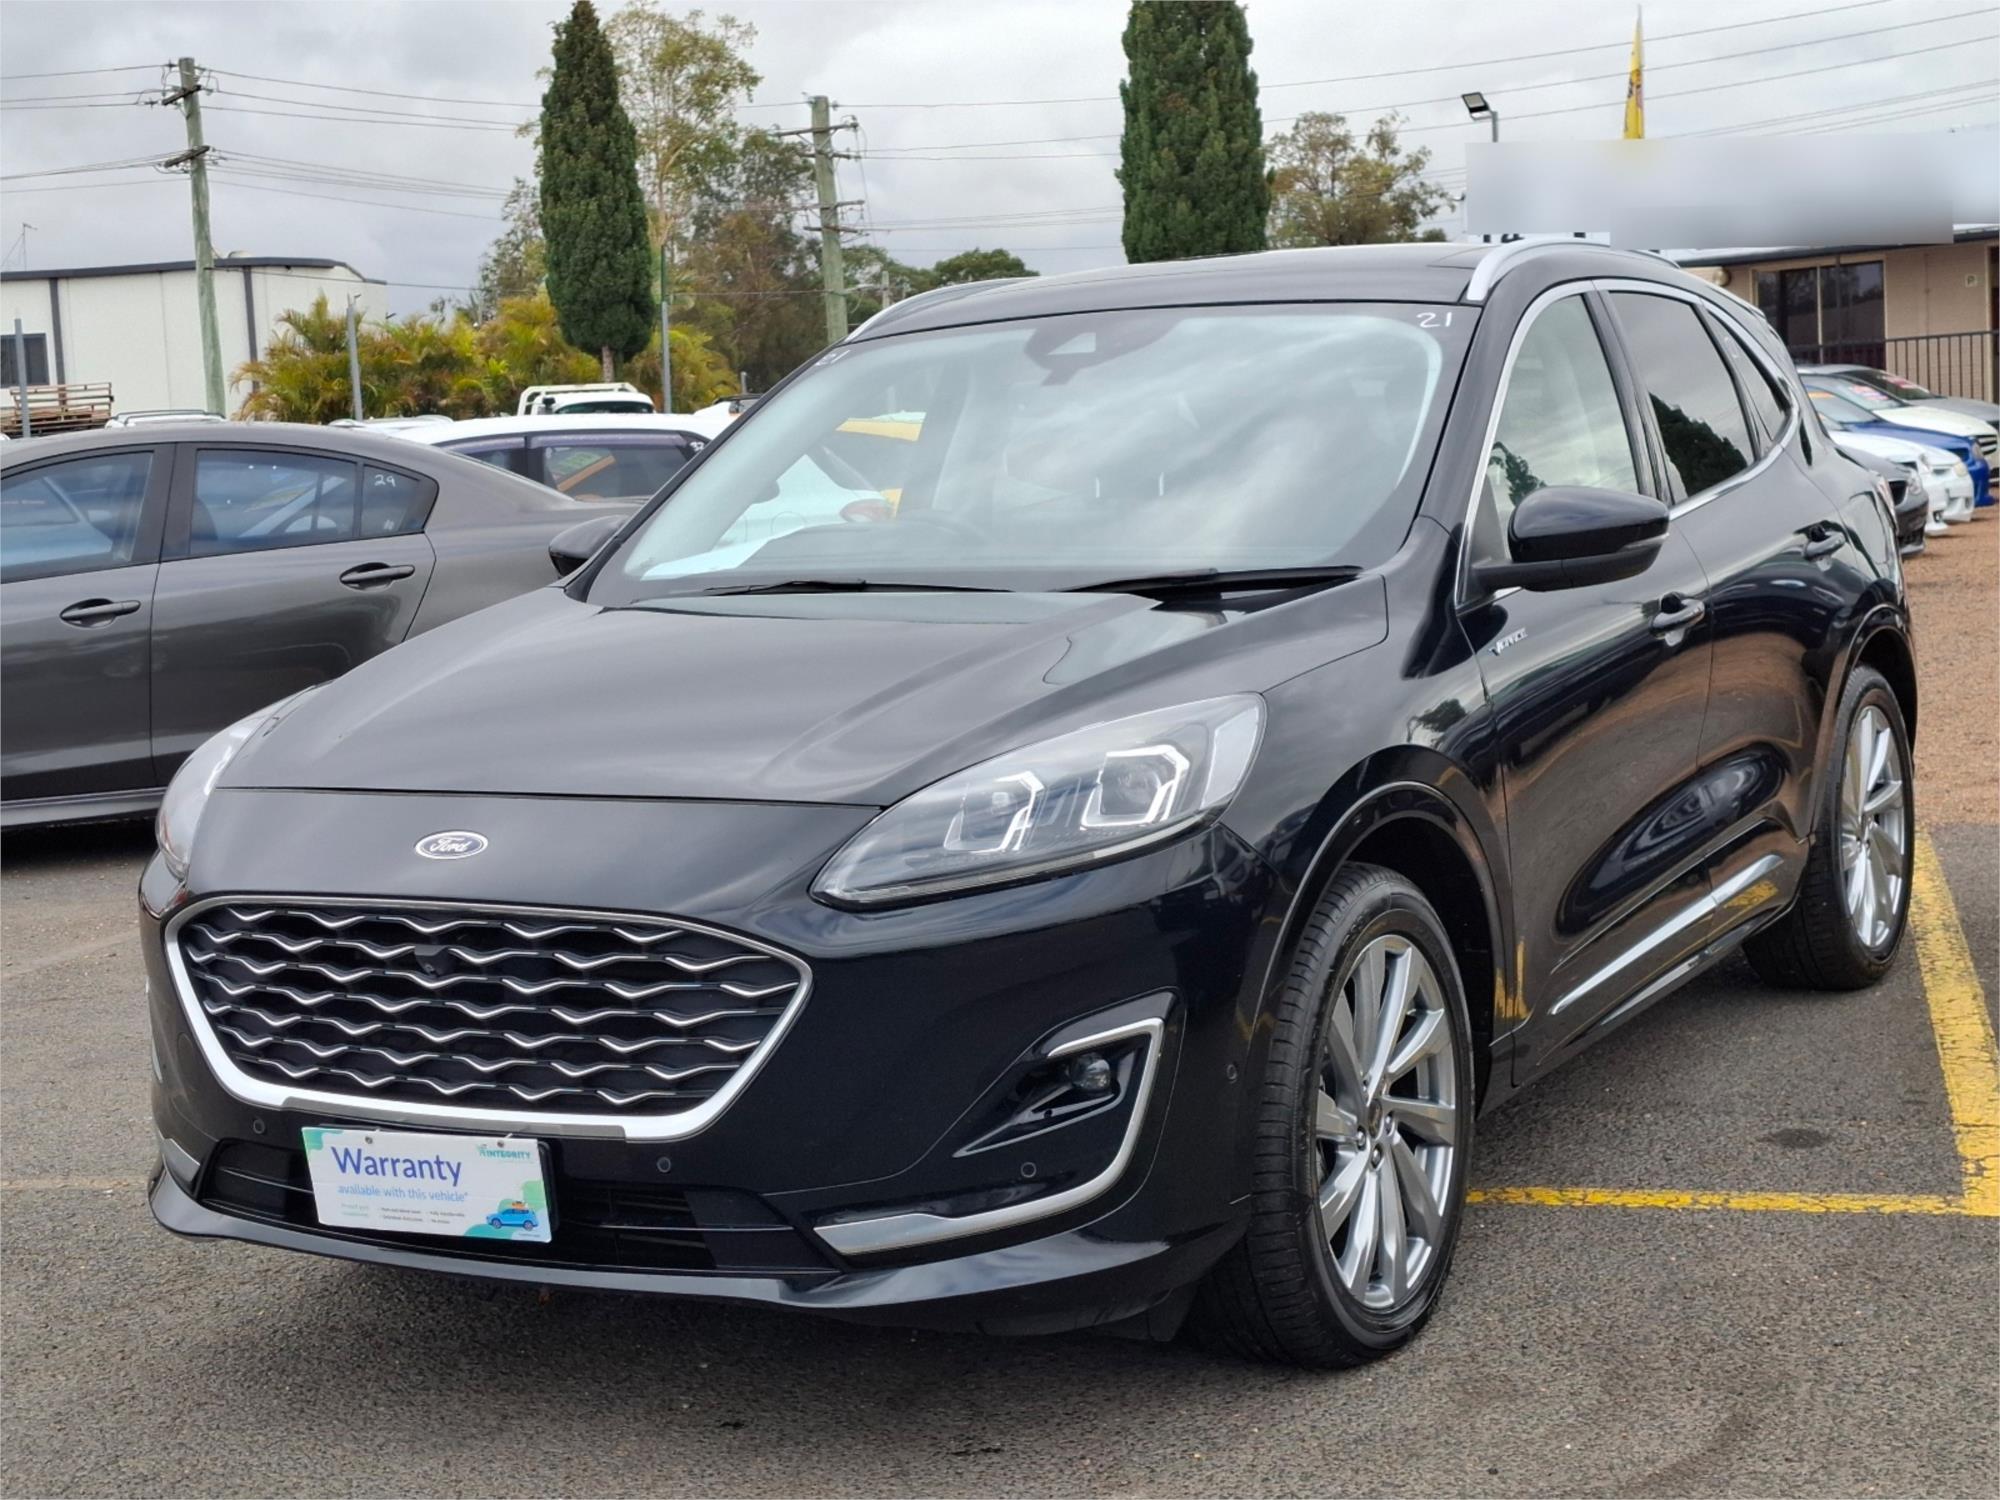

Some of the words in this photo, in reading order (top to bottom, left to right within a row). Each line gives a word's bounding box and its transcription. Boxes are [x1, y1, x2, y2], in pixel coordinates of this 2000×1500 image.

[1416, 312, 1452, 328] 21
[374, 474, 396, 487] 29
[429, 836, 473, 852] Ford
[331, 1146, 461, 1187] Warranty
[337, 1183, 380, 1197] available
[384, 1186, 406, 1199] with
[408, 1188, 427, 1200] this
